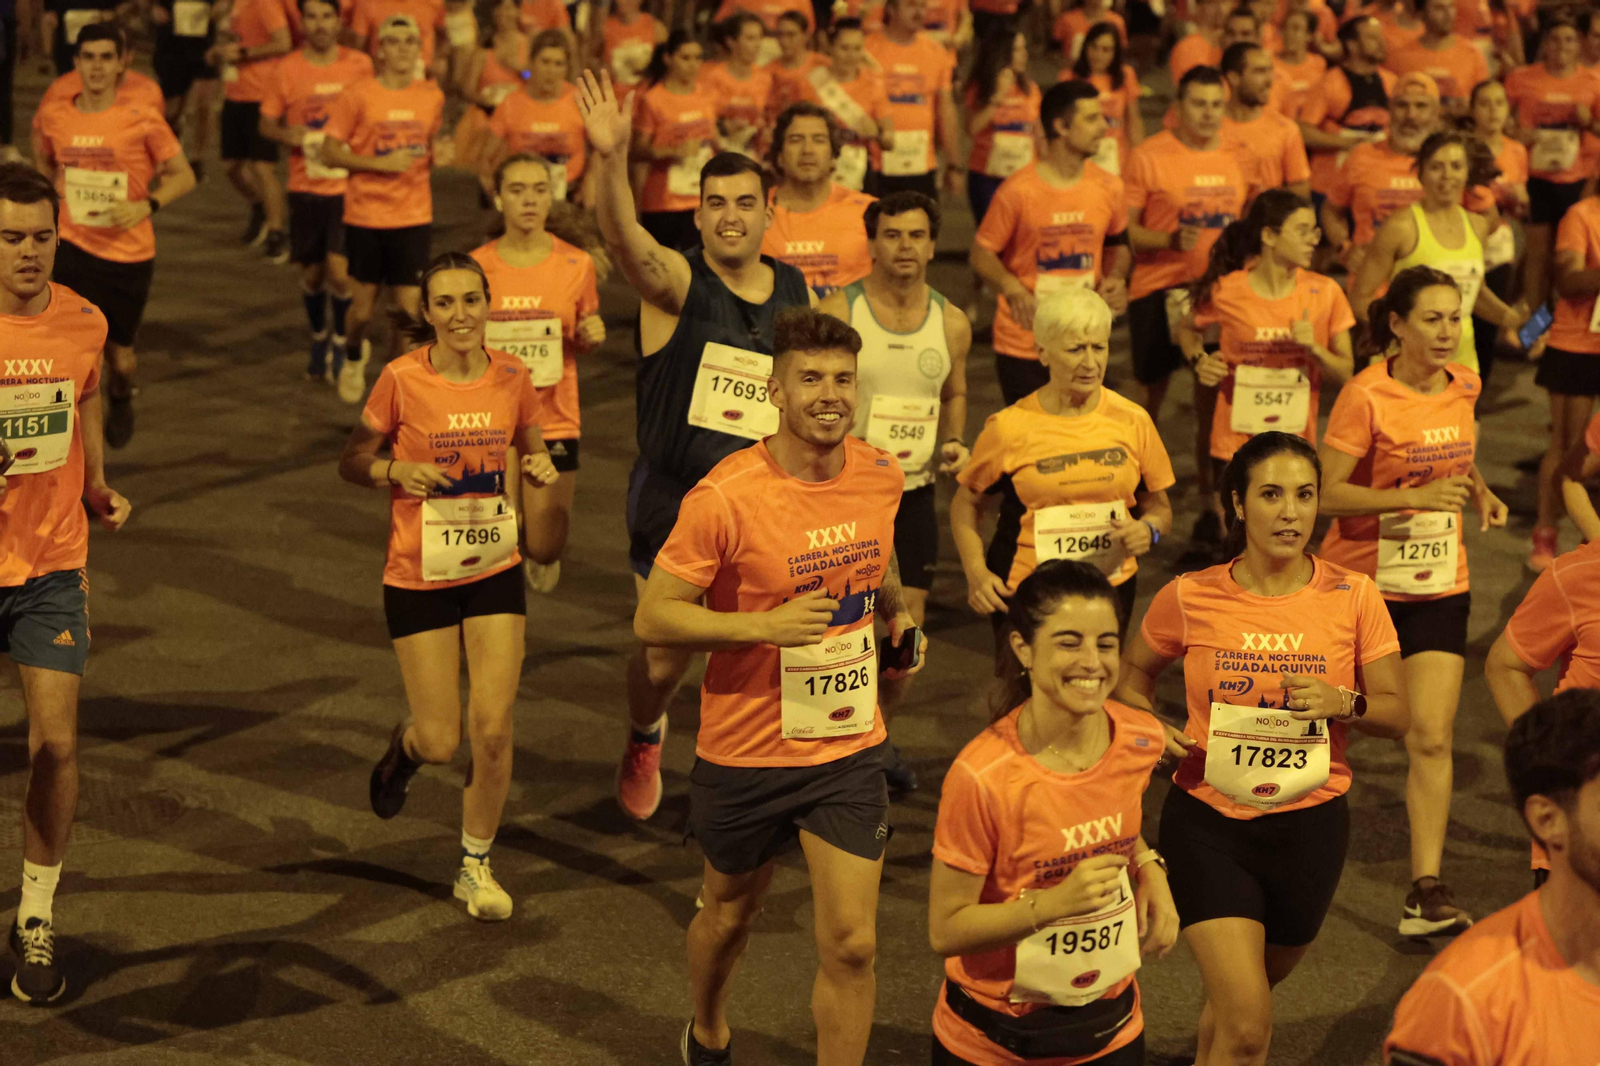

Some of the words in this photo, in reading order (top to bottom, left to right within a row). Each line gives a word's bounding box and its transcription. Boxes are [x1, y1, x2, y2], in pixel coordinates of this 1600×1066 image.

[501, 296, 542, 309] XXXV
[4, 359, 54, 376] XXXV
[711, 375, 768, 403] 17693
[1254, 391, 1293, 405] 5547
[3, 415, 48, 437] 1151
[447, 412, 492, 430] XXXV
[889, 424, 925, 440] 5549
[1422, 426, 1459, 444] XXXV
[441, 527, 500, 546] 17696
[805, 521, 856, 550] XXXV
[788, 550, 829, 565] CARRERA
[832, 539, 879, 556] NOCTURNA
[1397, 540, 1448, 560] 12761
[796, 548, 881, 575] GUADALQUIVIR
[1241, 632, 1304, 651] XXXV
[1215, 651, 1263, 661] CARRERA
[1269, 654, 1326, 662] NOCTURNA
[1222, 661, 1327, 674] GUADALQUIVIR
[805, 666, 869, 696] 17826
[1231, 745, 1308, 769] 17823
[1060, 812, 1122, 852] XXXV
[1034, 852, 1088, 869] CARRERA
[1046, 921, 1123, 955] 19587
